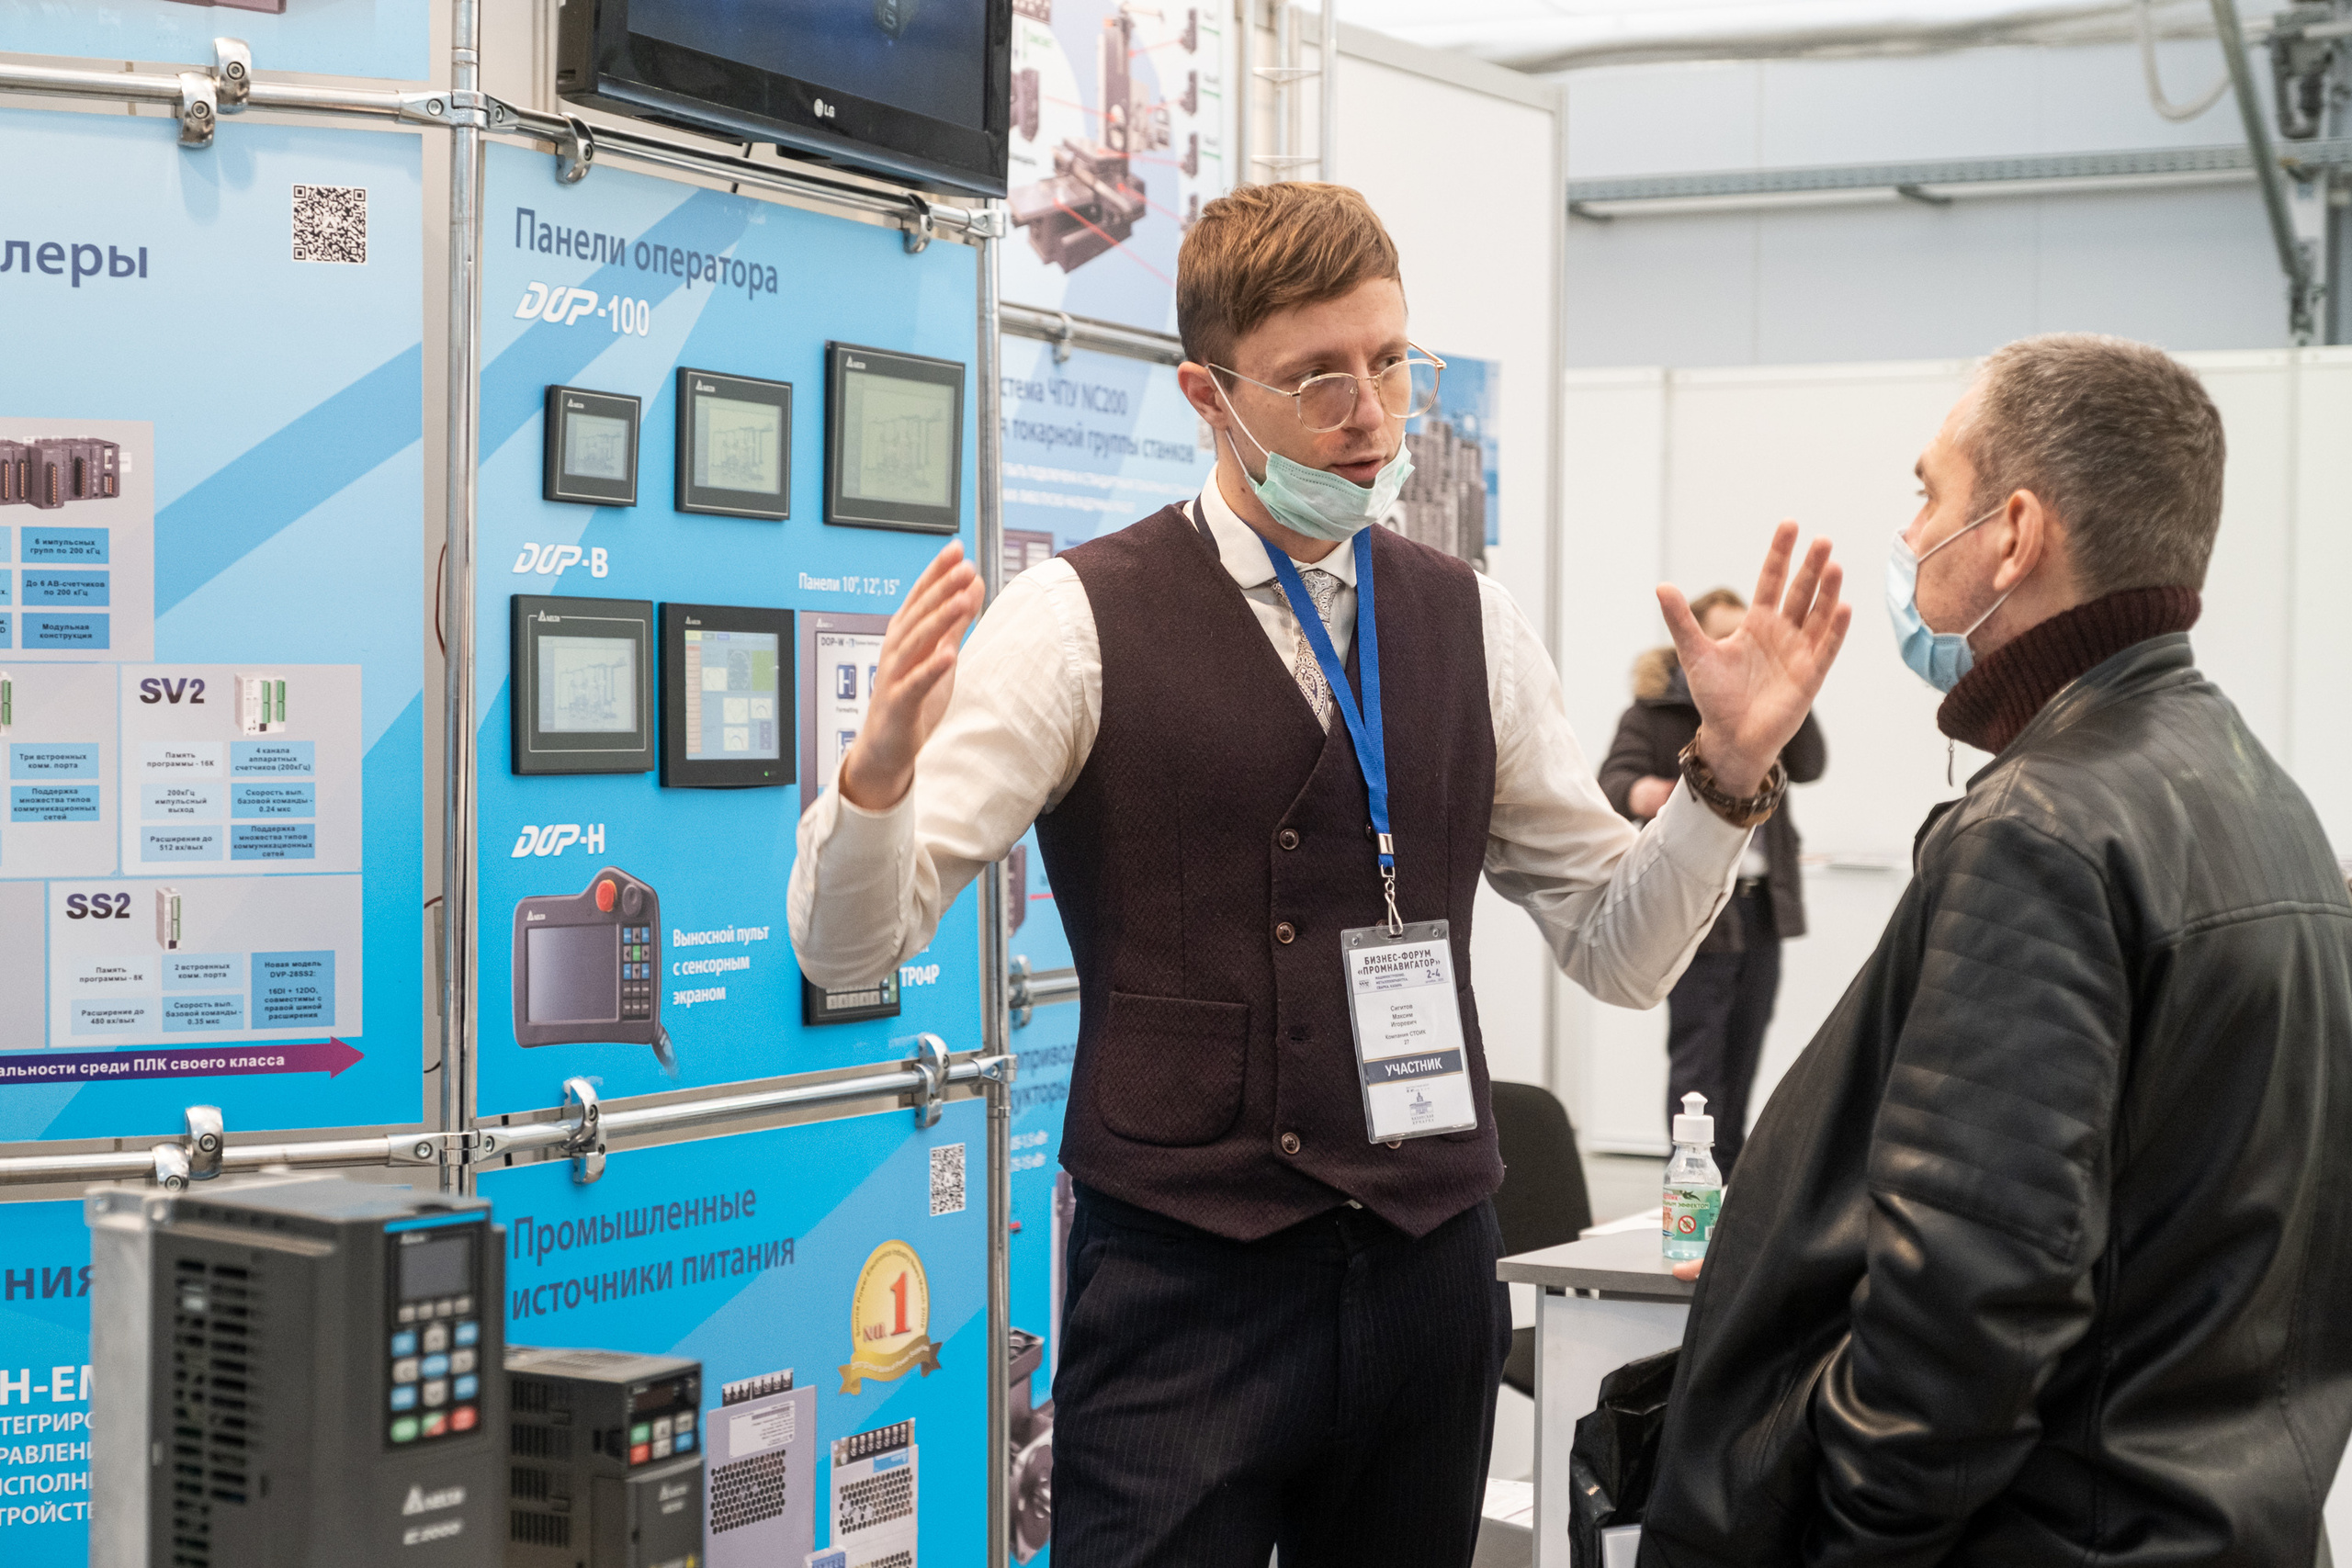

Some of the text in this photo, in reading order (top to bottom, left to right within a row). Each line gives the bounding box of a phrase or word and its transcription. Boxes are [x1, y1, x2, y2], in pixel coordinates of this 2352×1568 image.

[823, 103, 836, 118] LG
[515, 207, 778, 300] Панели оператора
[0, 239, 149, 288] леры
[26, 580, 38, 588] До
[798, 571, 840, 592] Панели
[140, 678, 205, 704] SV2
[277, 763, 311, 772] (200кГц)
[167, 789, 195, 797] 200кГц
[237, 796, 270, 805] базовой
[272, 797, 307, 806] команды
[245, 789, 283, 797] Скорость
[251, 825, 295, 833] Поддержка
[151, 835, 200, 843] Расширение
[175, 843, 203, 852] вх/вых
[262, 850, 285, 858] сетей
[66, 892, 131, 919] SS2
[673, 923, 770, 949] Выносной пульт
[1363, 949, 1431, 965] БИЗНЕС-ФОРУМ
[673, 955, 751, 976] с сенсорным
[1357, 958, 1441, 976] «ПРОМНАВИГАТОР»
[1426, 968, 1441, 978] 2-4
[899, 964, 940, 987] TP04P
[673, 987, 727, 1007] экраном
[81, 1009, 132, 1017] Расширение
[165, 1010, 199, 1018] базовой
[201, 1010, 237, 1018] команды
[265, 1002, 322, 1012] правой шиной
[268, 1012, 318, 1021] расширения
[1391, 1020, 1417, 1028] Игоревич
[0, 1055, 285, 1077] альности среди ПЛК своего класса
[1385, 1057, 1442, 1077] УЧАСТНИК
[513, 1189, 757, 1267] Промышленные
[512, 1236, 796, 1321] источники питания
[889, 1270, 912, 1337] 1
[0, 1472, 93, 1496] СПОЛН
